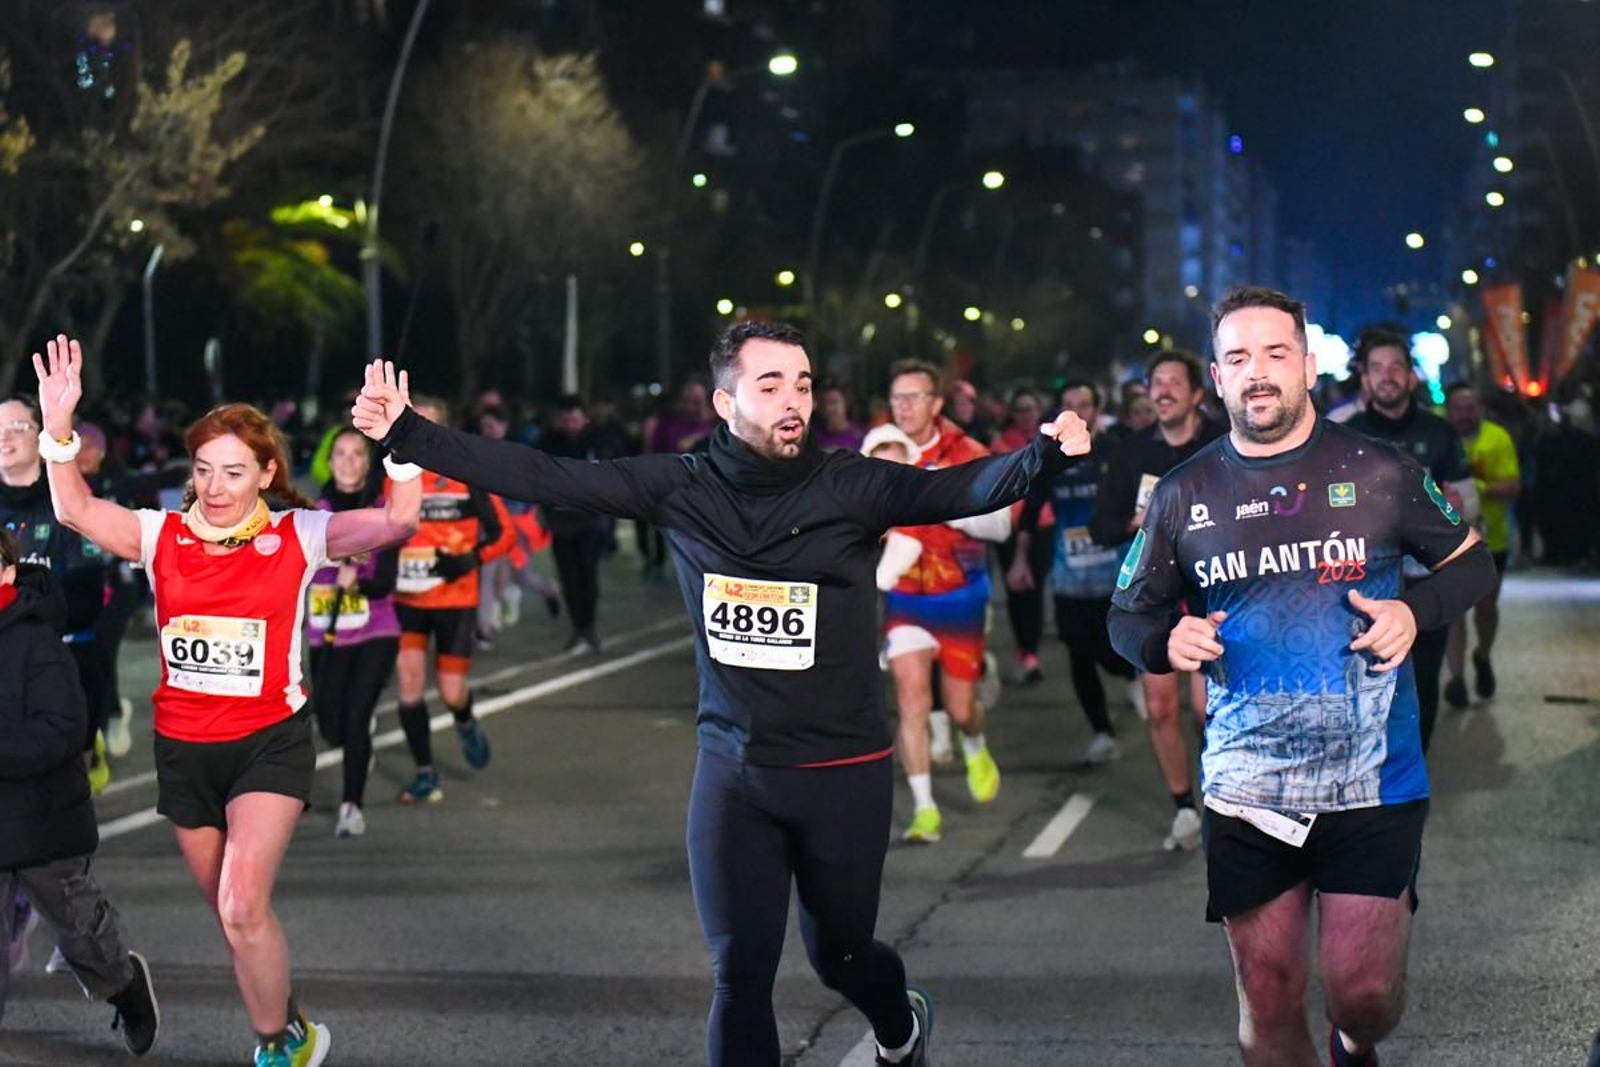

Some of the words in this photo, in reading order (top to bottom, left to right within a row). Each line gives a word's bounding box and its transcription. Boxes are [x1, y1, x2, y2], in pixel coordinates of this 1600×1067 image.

[1194, 550, 1248, 588] SAN
[1258, 530, 1366, 576] ANTÓN
[1317, 559, 1367, 584] 2025
[724, 582, 744, 598] 42
[183, 618, 200, 633] 42
[710, 602, 805, 636] 4896
[171, 637, 254, 666] 6039
